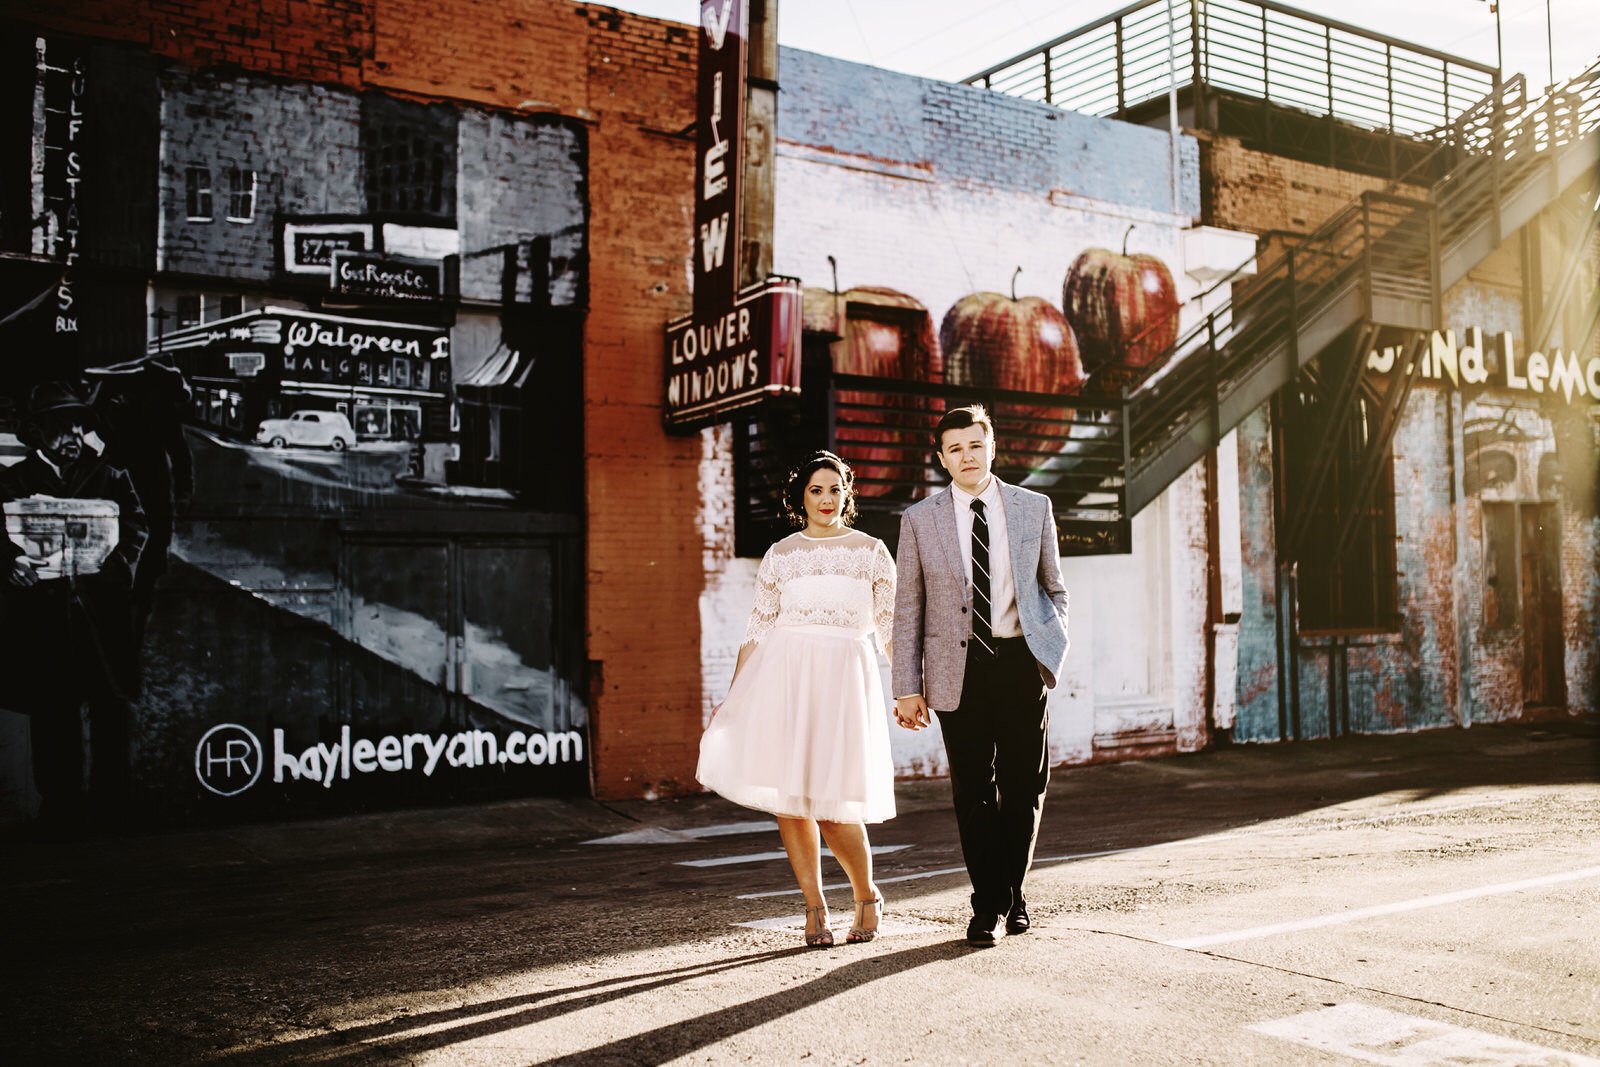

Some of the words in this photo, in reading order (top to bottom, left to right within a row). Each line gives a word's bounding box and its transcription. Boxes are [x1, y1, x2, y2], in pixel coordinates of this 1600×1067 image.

[284, 321, 421, 357] Walgreen
[672, 308, 750, 364] LOUVER
[668, 350, 758, 406] WINDOWS
[207, 740, 252, 777] HR
[273, 725, 583, 788] hayleeryan.com
